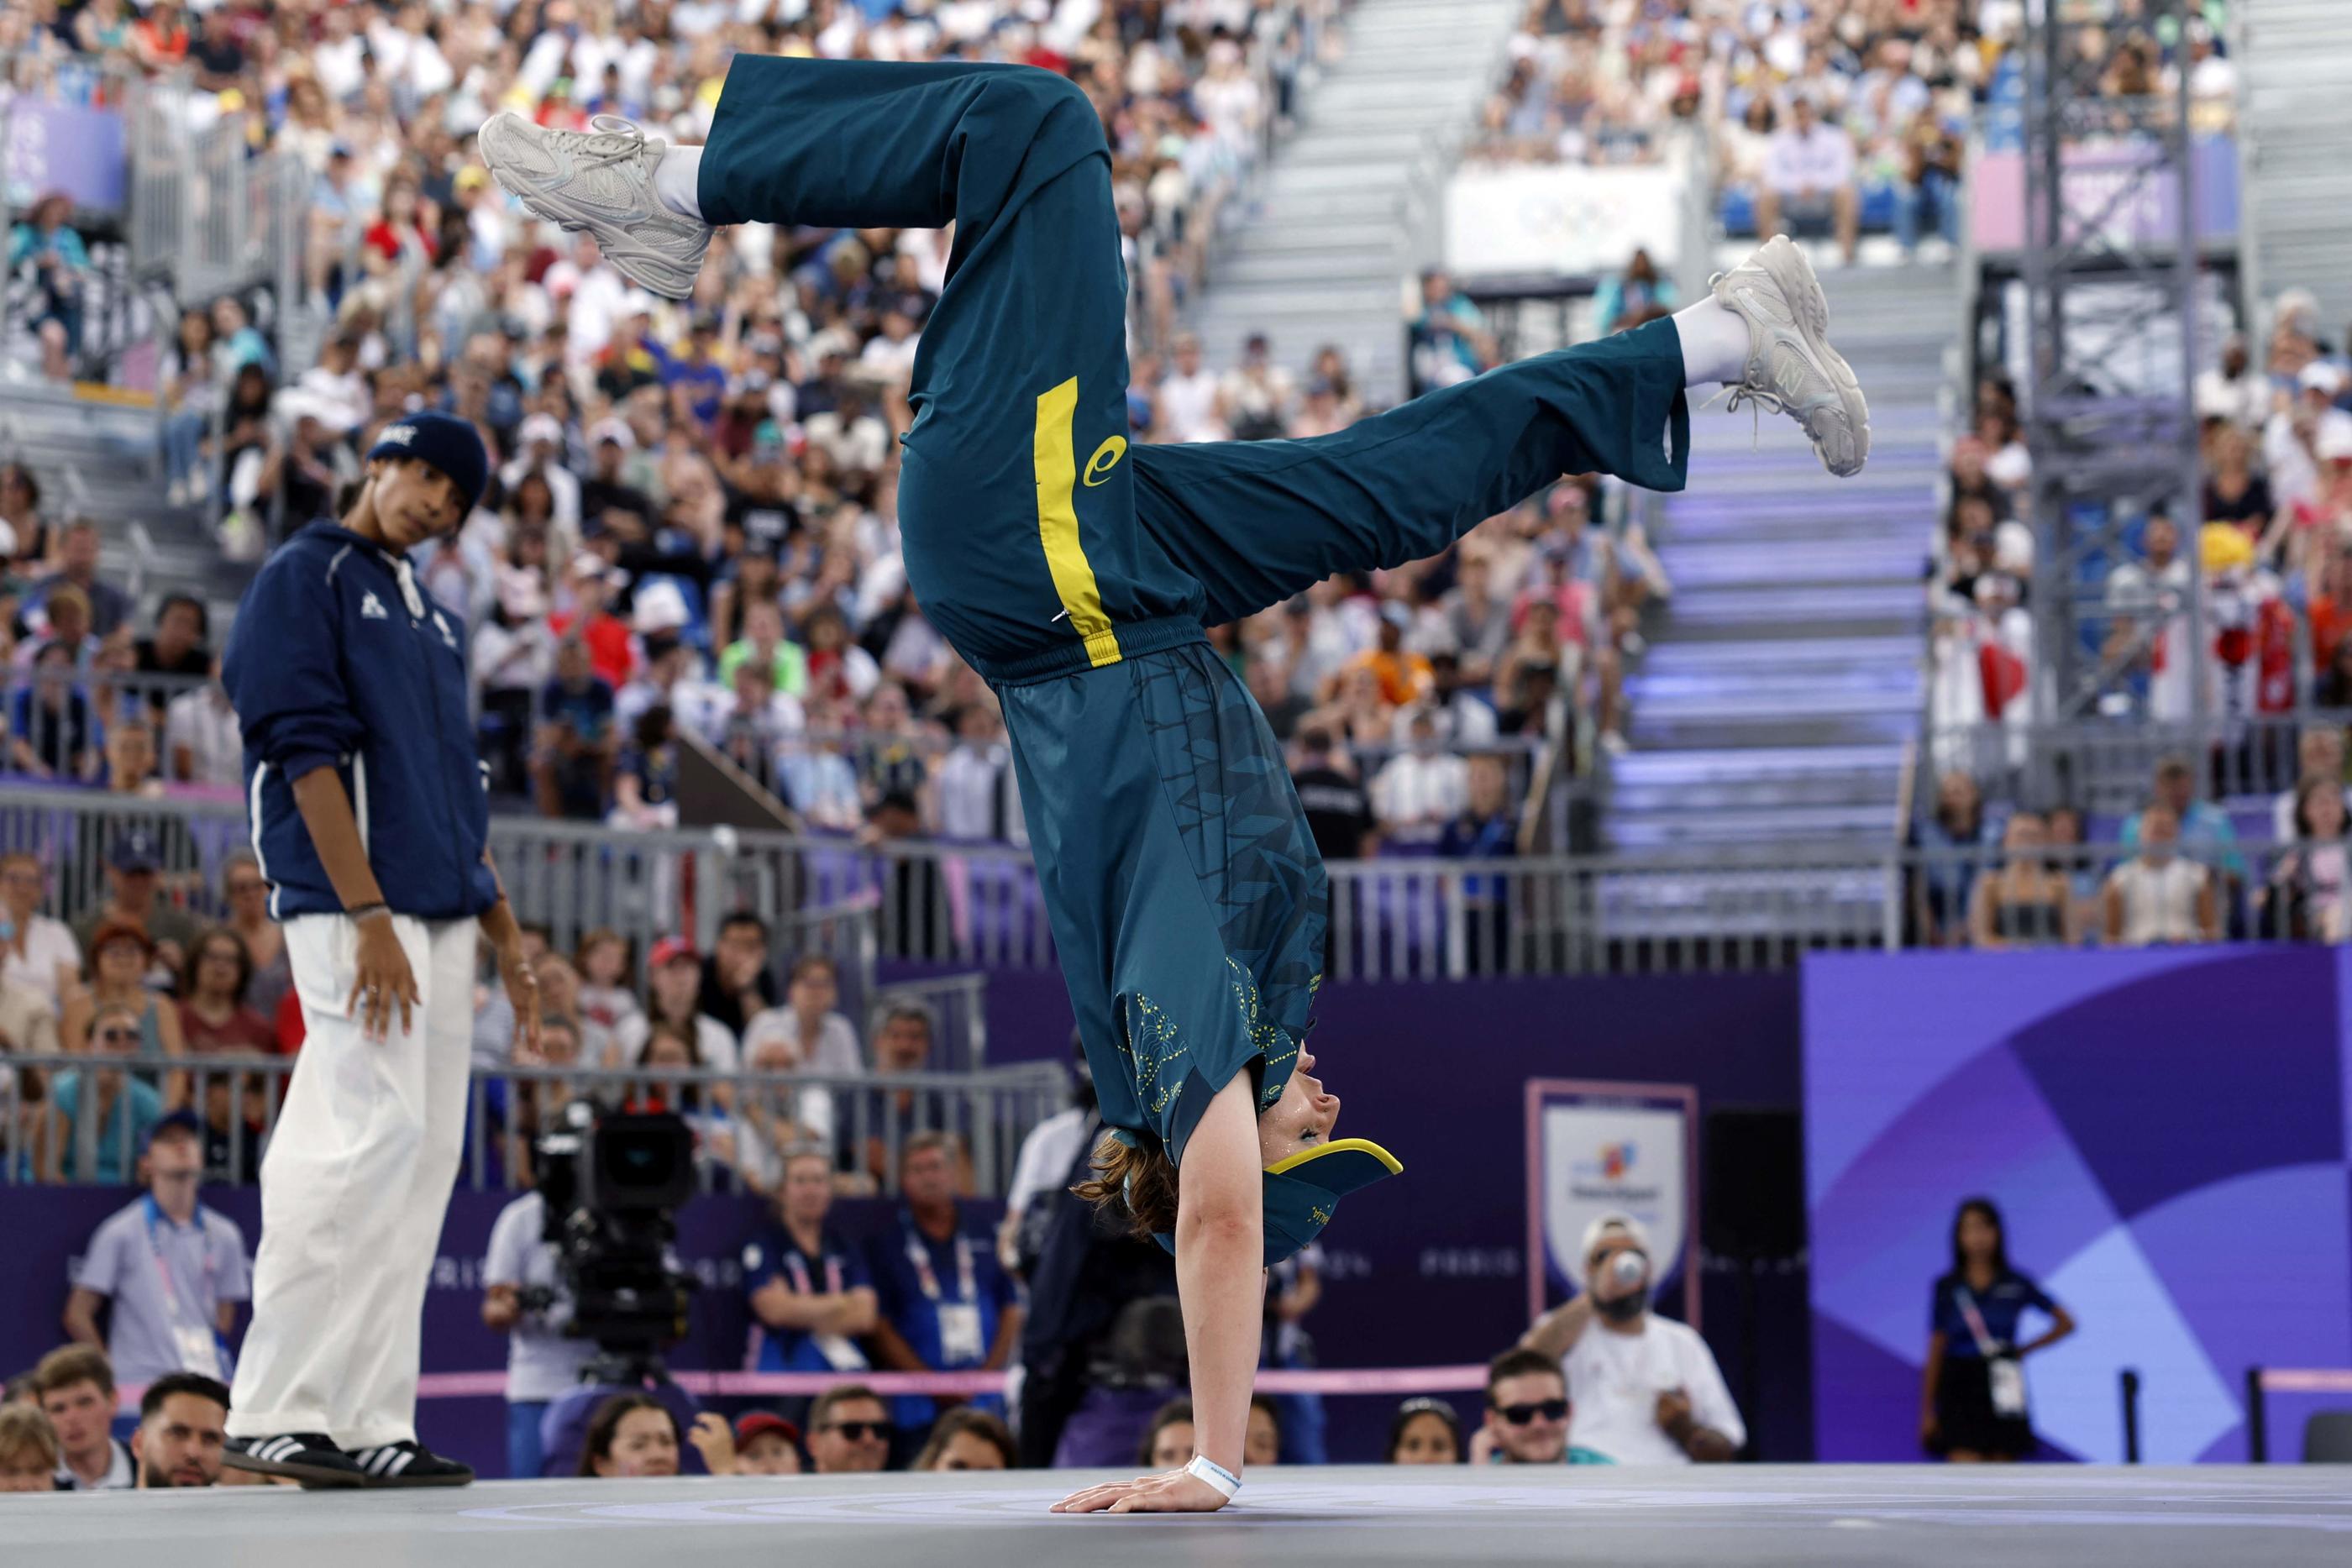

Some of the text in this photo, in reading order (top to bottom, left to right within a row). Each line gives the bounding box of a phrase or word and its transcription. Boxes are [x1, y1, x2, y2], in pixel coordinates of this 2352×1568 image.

[587, 170, 614, 199] N
[1775, 358, 1804, 397] N
[1420, 1249, 1519, 1276] PARIS
